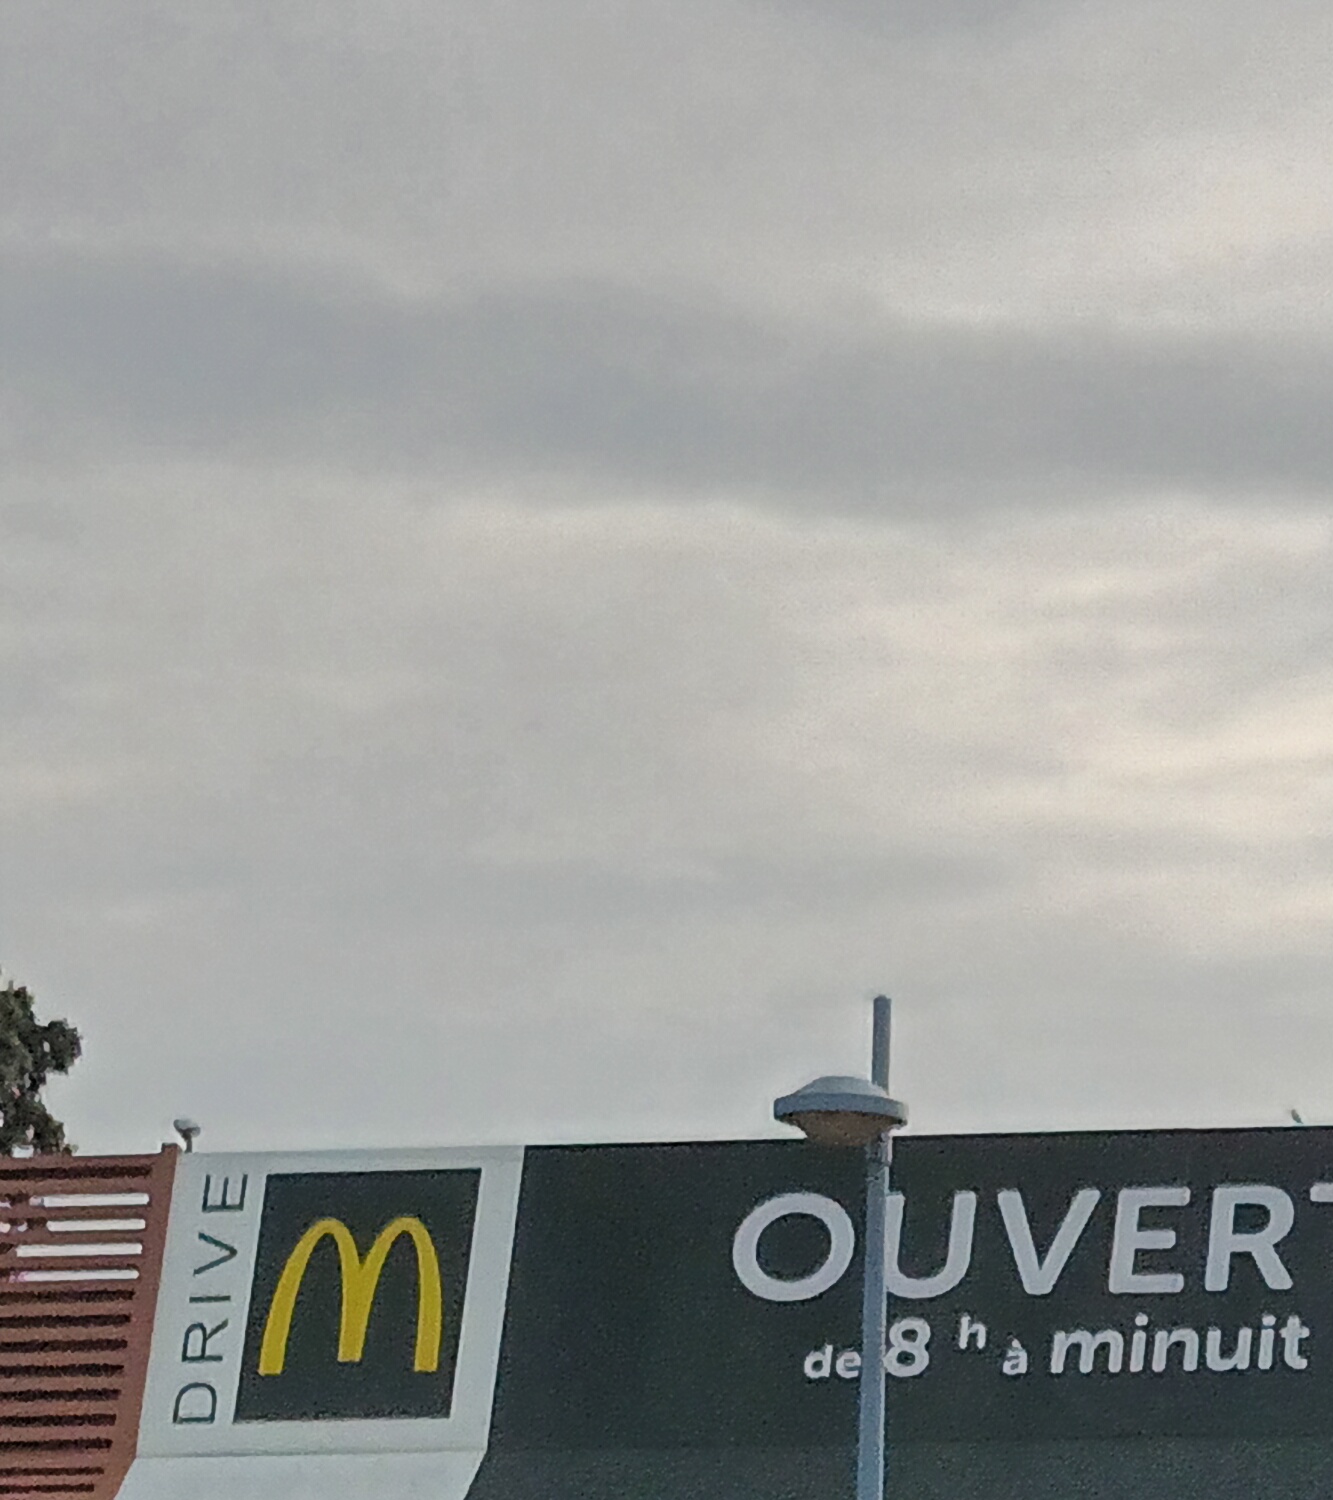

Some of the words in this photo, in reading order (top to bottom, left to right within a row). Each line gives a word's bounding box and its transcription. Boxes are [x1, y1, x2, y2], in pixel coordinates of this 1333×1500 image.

[173, 1174, 248, 1424] DRIVE
[803, 1344, 862, 1379] de
[1001, 1339, 1028, 1375] à
[1050, 1313, 1310, 1374] minuit
